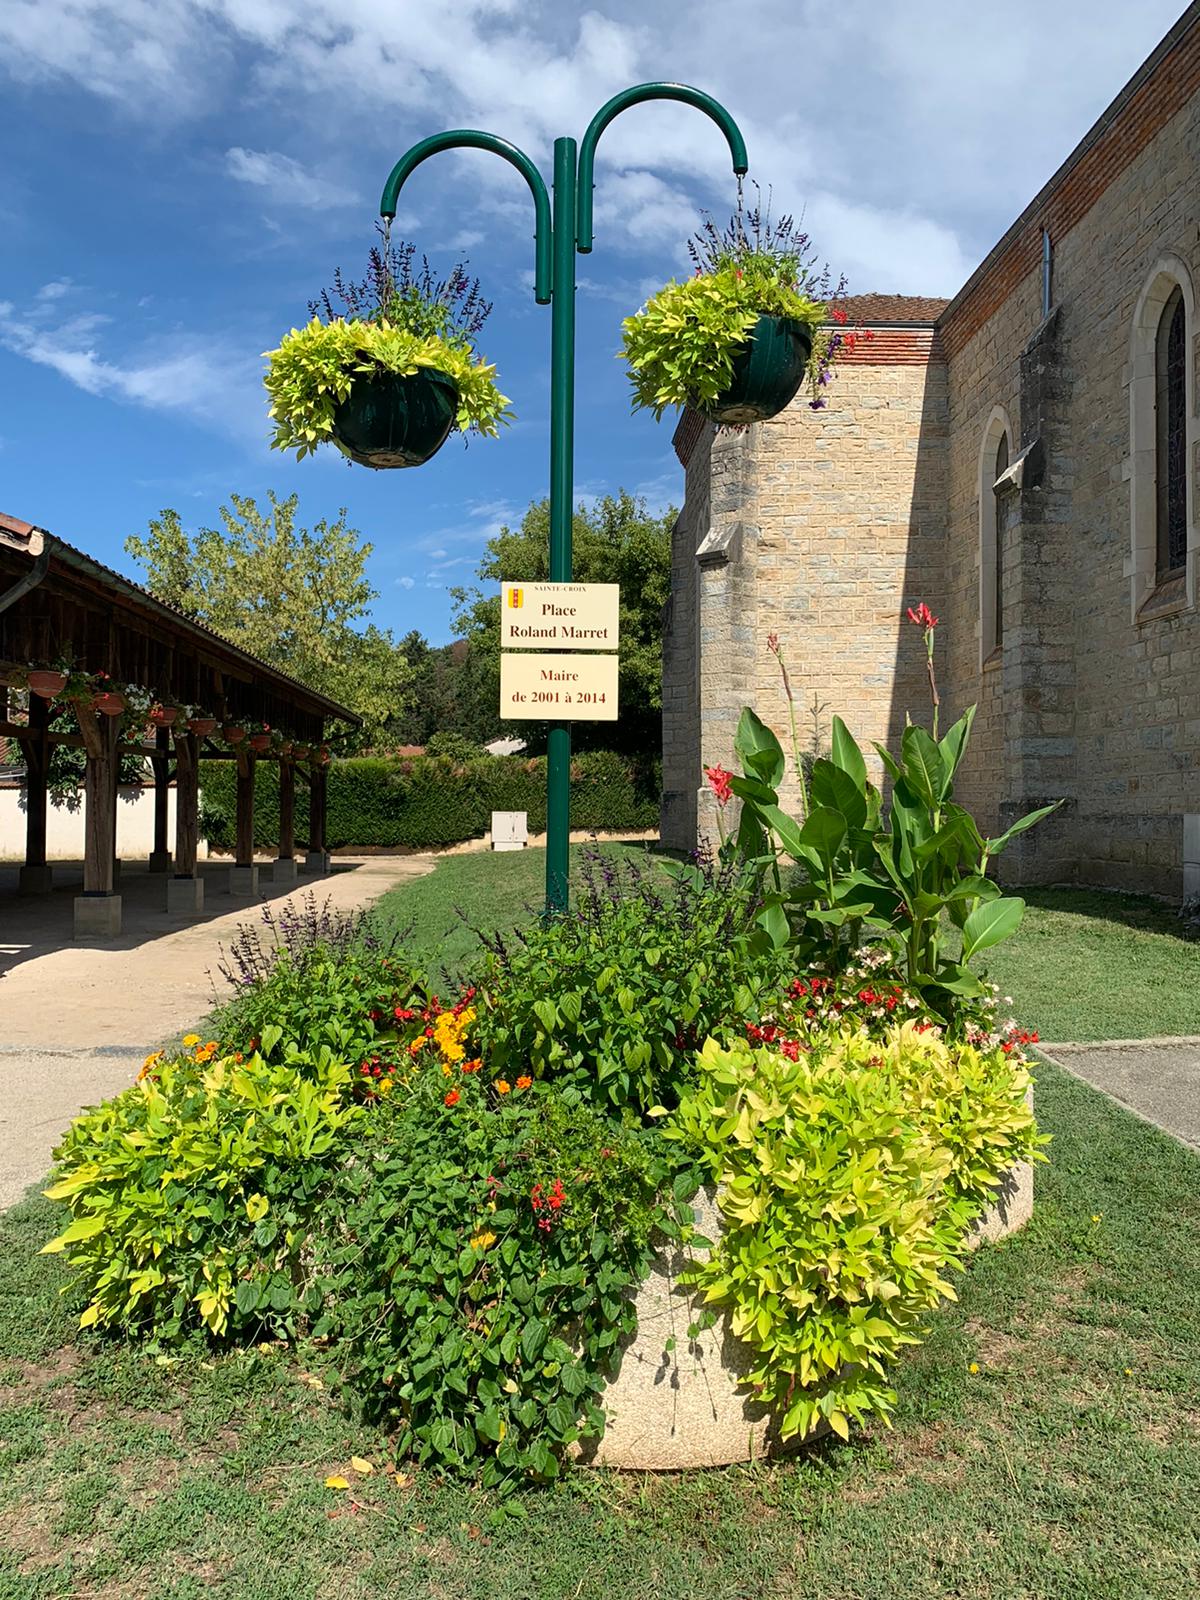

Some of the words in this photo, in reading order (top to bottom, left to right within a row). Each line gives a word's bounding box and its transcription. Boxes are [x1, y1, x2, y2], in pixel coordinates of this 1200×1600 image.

[541, 603, 577, 617] Place
[510, 625, 557, 638] Roland
[561, 626, 608, 639] Marret
[540, 669, 579, 681] Maire
[511, 691, 527, 703] de
[531, 692, 559, 703] 2001
[564, 691, 572, 703] à
[576, 692, 606, 704] 2014
